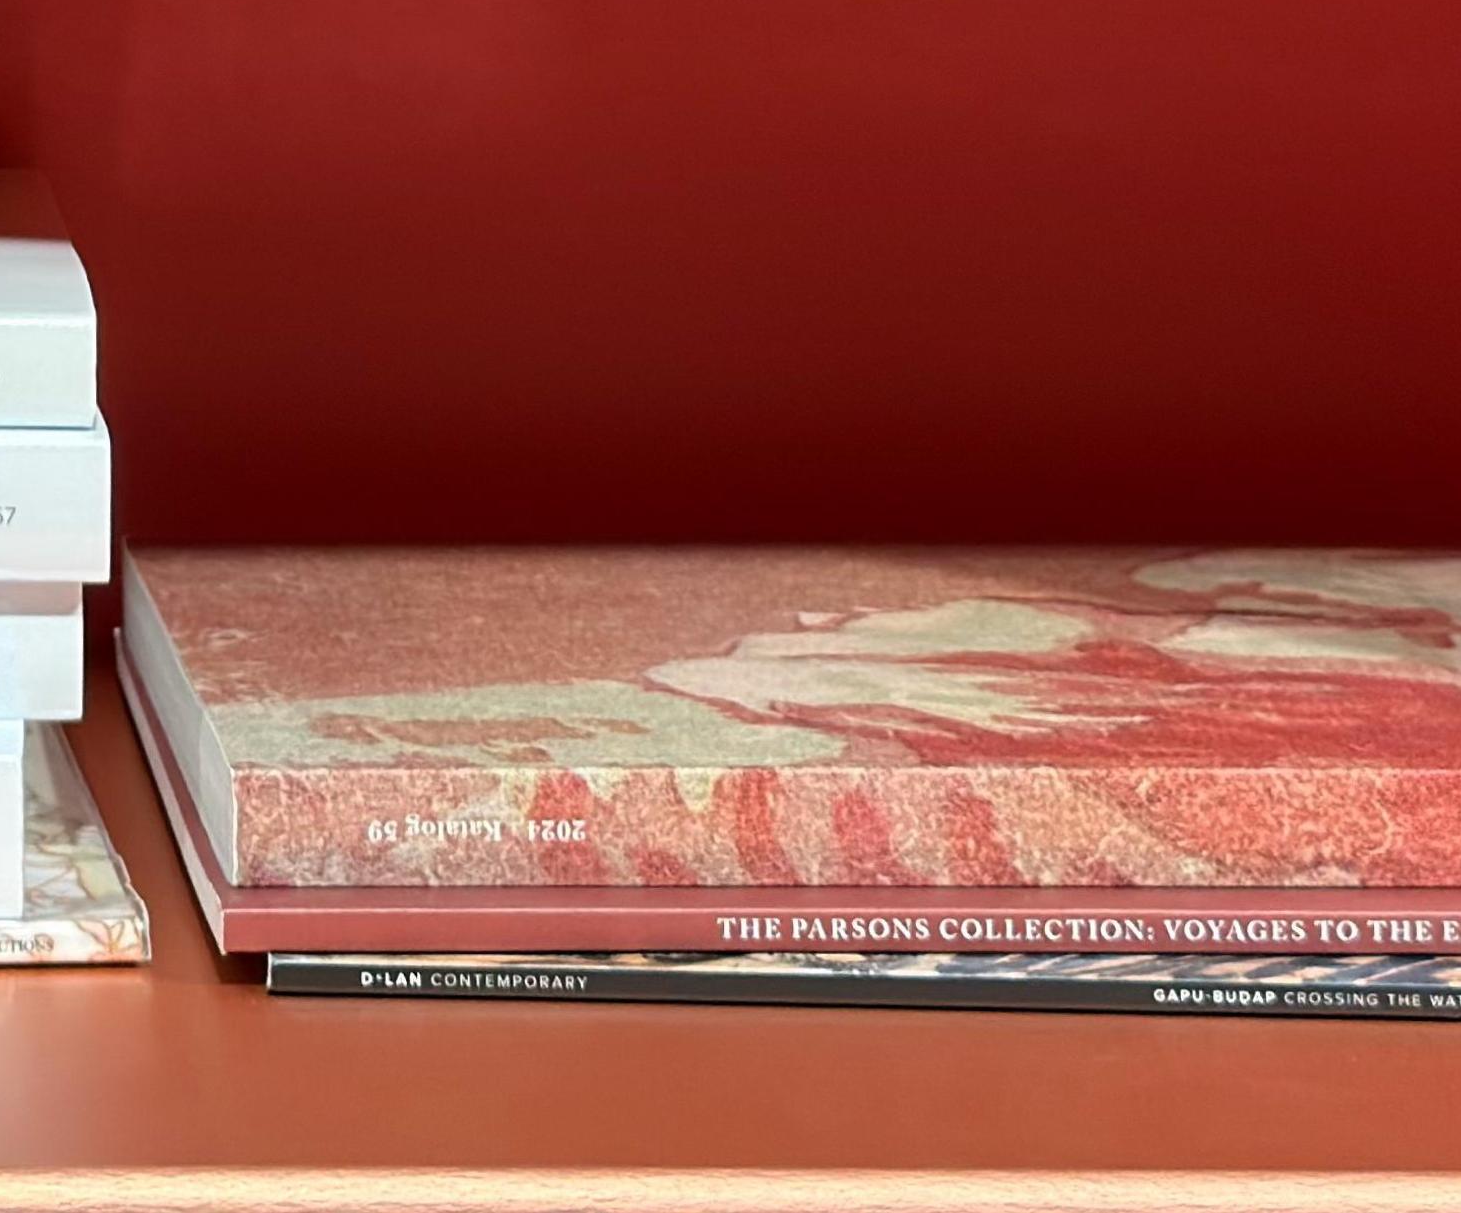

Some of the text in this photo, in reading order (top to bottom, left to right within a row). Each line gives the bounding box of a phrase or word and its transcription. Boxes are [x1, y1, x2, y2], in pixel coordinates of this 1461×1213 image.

[368, 814, 586, 843] 2024 Katalog 59
[718, 916, 782, 941] THE
[791, 917, 929, 941] PARSONS
[939, 918, 1155, 942] COLLECTION:
[1165, 918, 1306, 943] VOYAGES
[1315, 920, 1359, 943] TO
[1368, 920, 1433, 943] THE
[430, 973, 588, 990] CONTEMPORARY
[1283, 991, 1379, 1007] CROSSING
[1387, 993, 1421, 1007] THE
